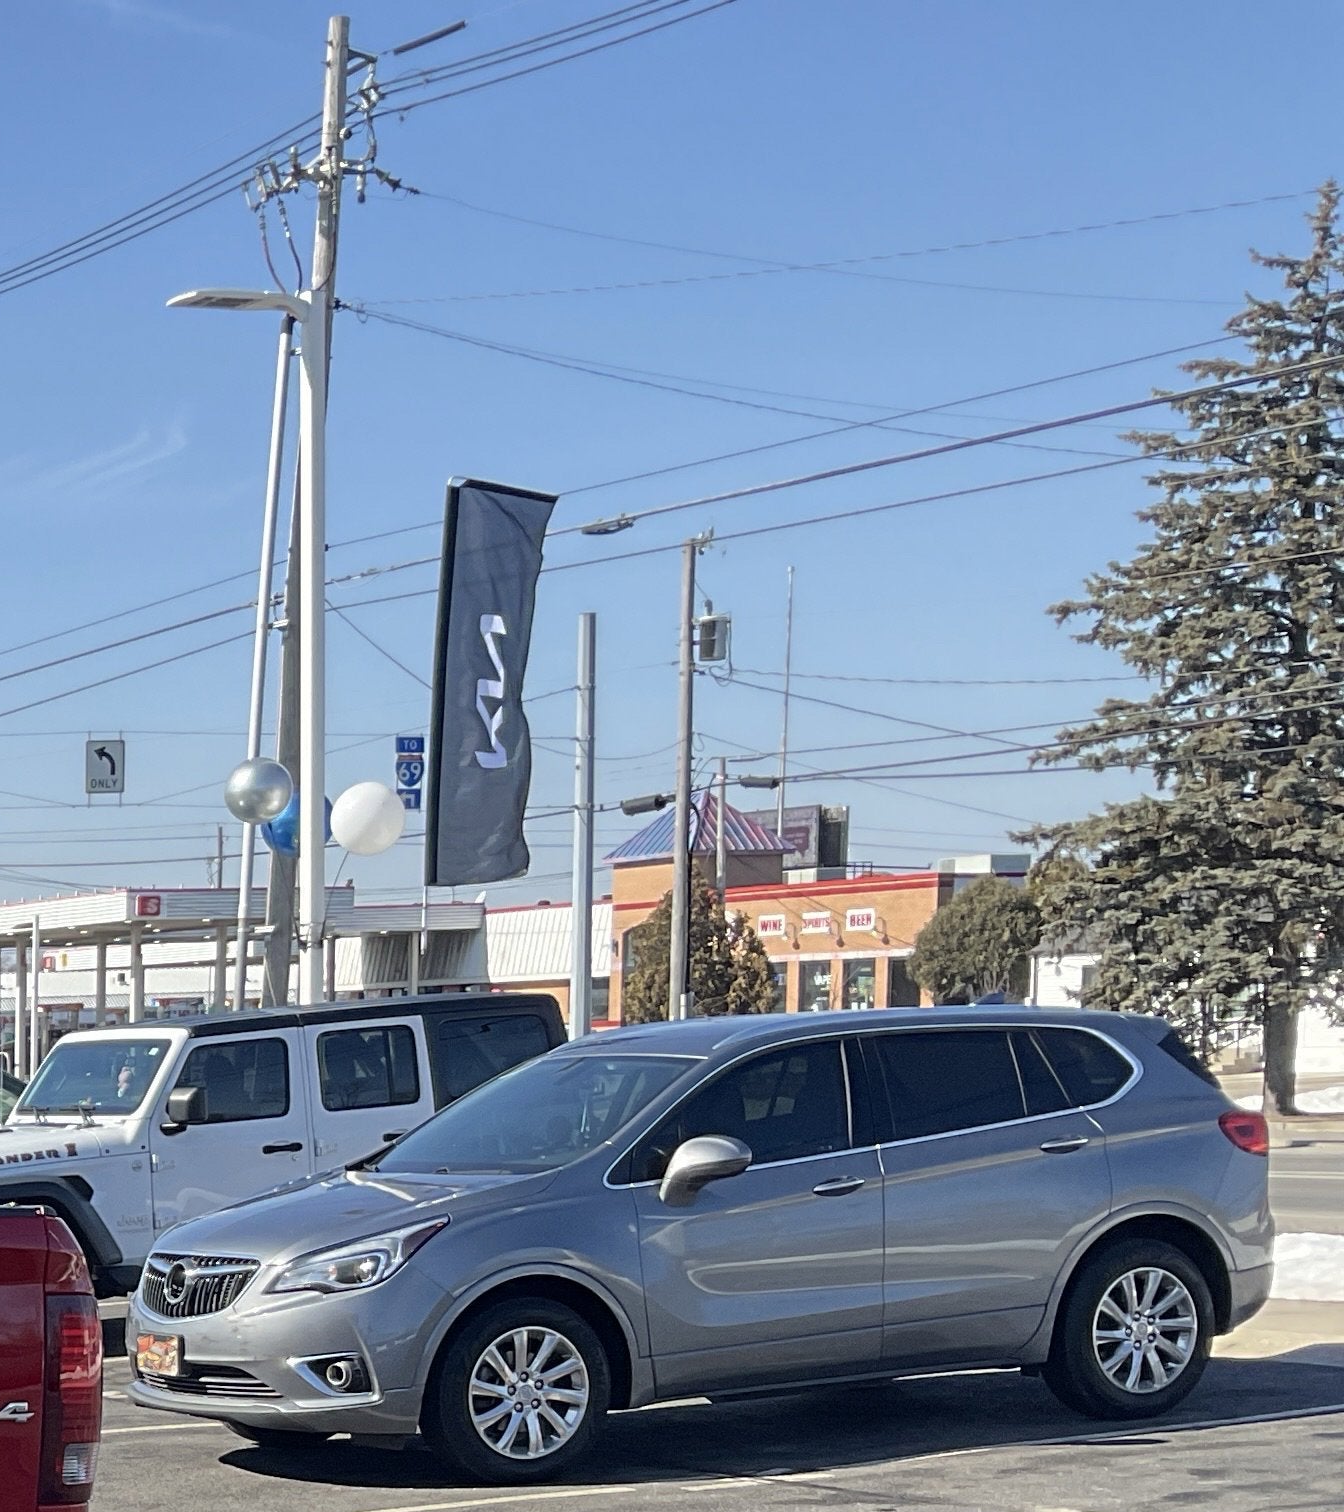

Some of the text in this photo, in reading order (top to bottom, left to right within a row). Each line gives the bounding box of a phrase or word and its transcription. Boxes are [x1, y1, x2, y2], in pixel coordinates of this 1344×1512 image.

[403, 740, 418, 750] TO
[398, 762, 422, 781] 69
[90, 778, 118, 789] ONLY
[760, 919, 783, 932] WINE
[849, 913, 872, 927] BEER
